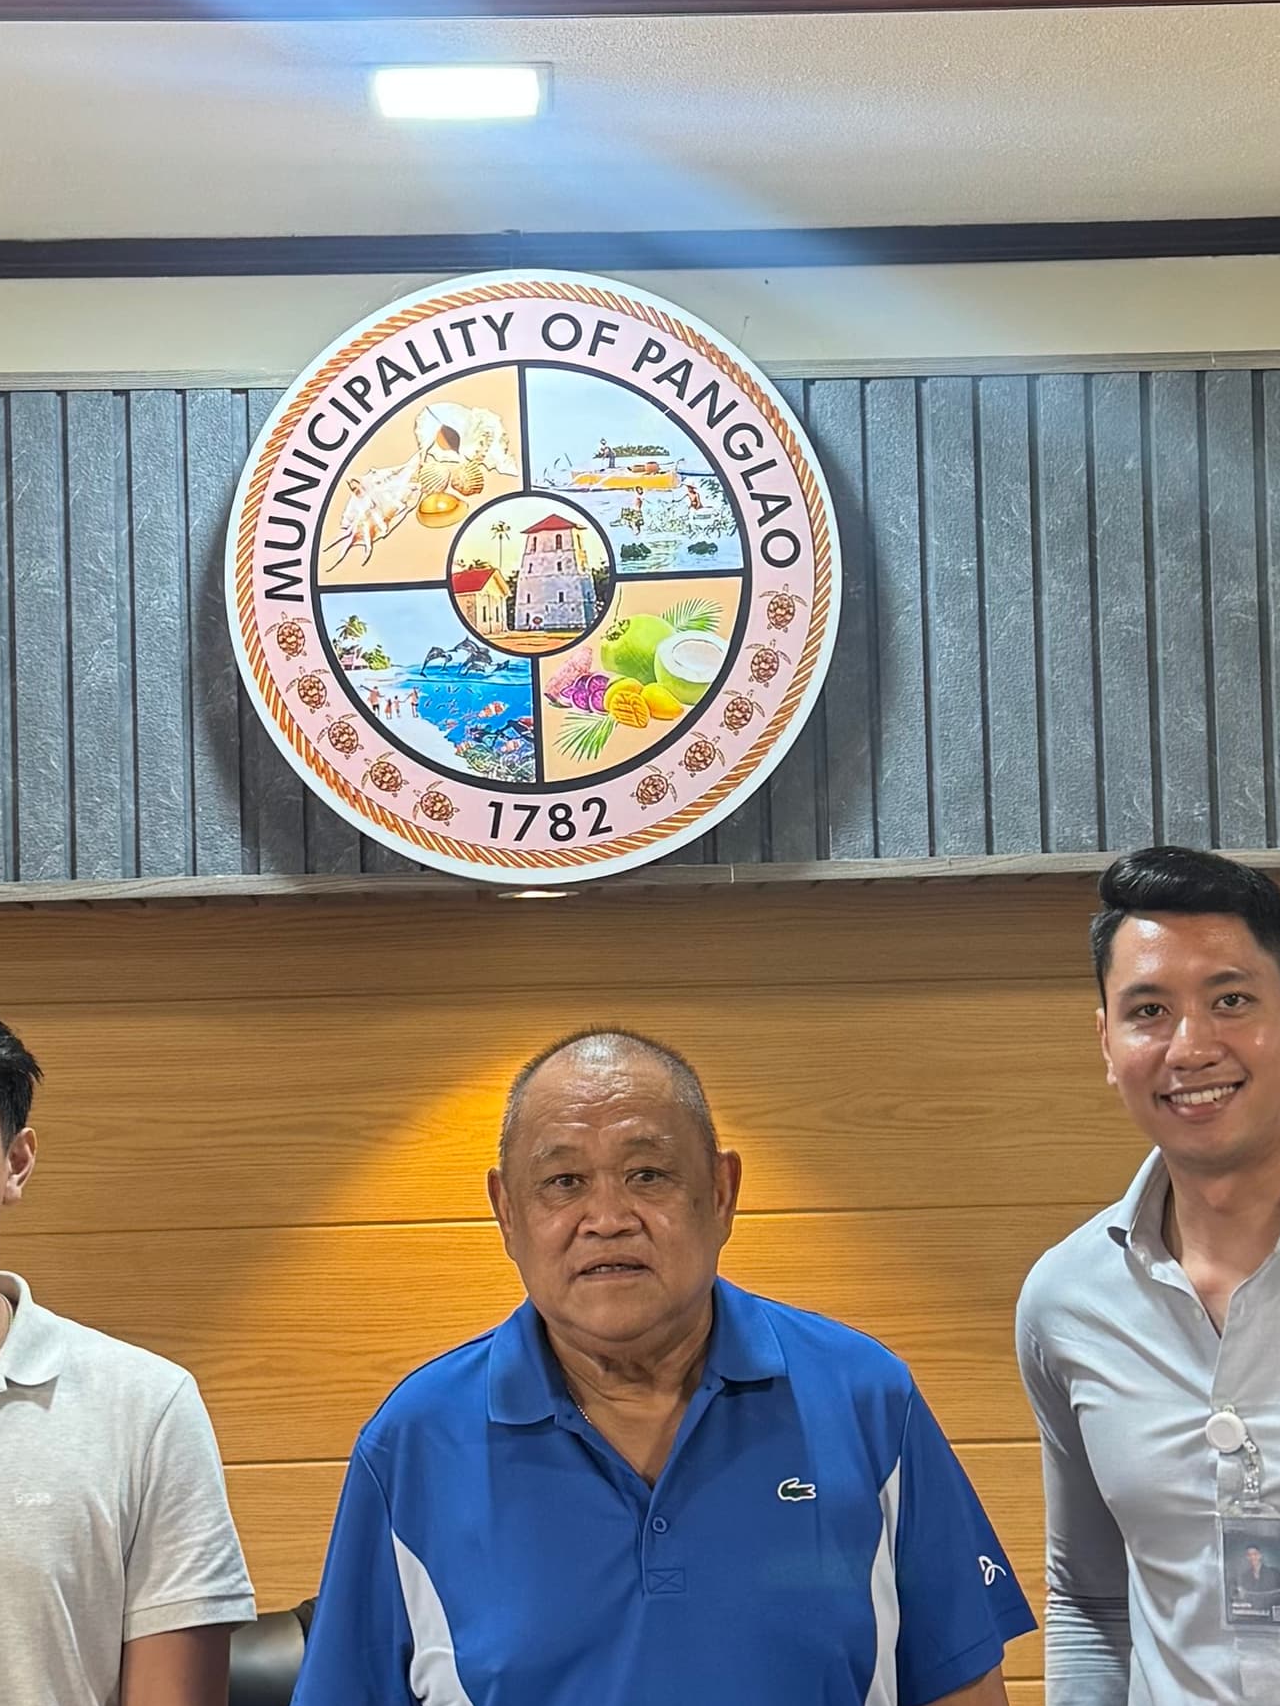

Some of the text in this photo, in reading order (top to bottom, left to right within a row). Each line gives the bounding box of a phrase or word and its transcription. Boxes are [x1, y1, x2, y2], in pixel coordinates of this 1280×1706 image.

[264, 311, 802, 603] MUNICIPALITY OF PANGLAO
[486, 797, 613, 843] 1782
